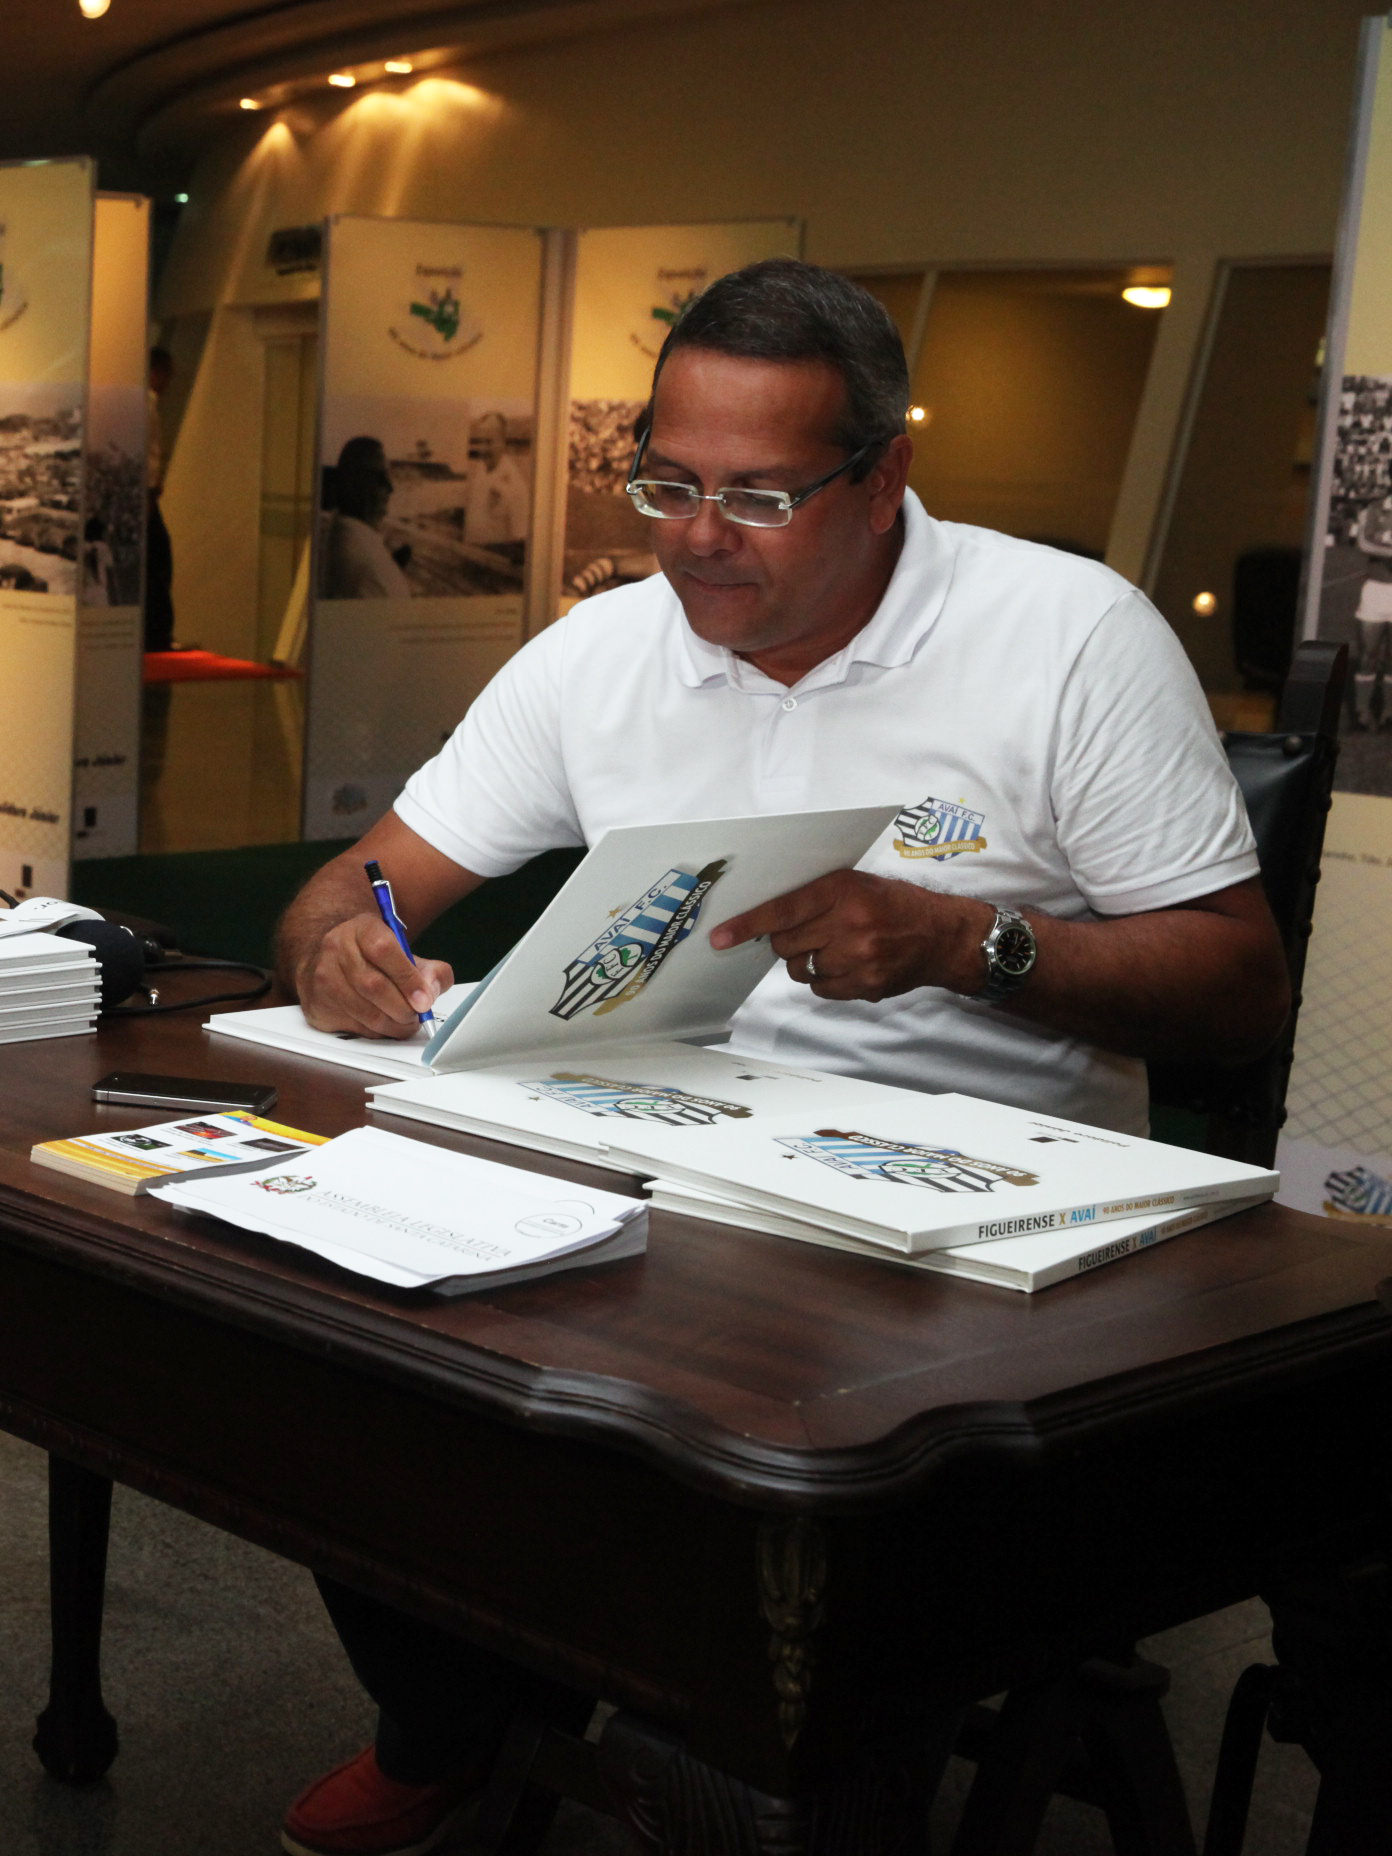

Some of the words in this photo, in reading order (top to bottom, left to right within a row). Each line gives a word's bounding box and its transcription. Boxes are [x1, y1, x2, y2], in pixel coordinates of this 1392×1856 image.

[978, 1213, 1055, 1239] FIGUEIRENSE
[1058, 1211, 1066, 1226] X
[1070, 1204, 1096, 1224] AVAÍ
[1125, 1202, 1134, 1212] DO
[1134, 1199, 1151, 1210] MAIOR
[1078, 1240, 1130, 1271] FIGUEIRENSE
